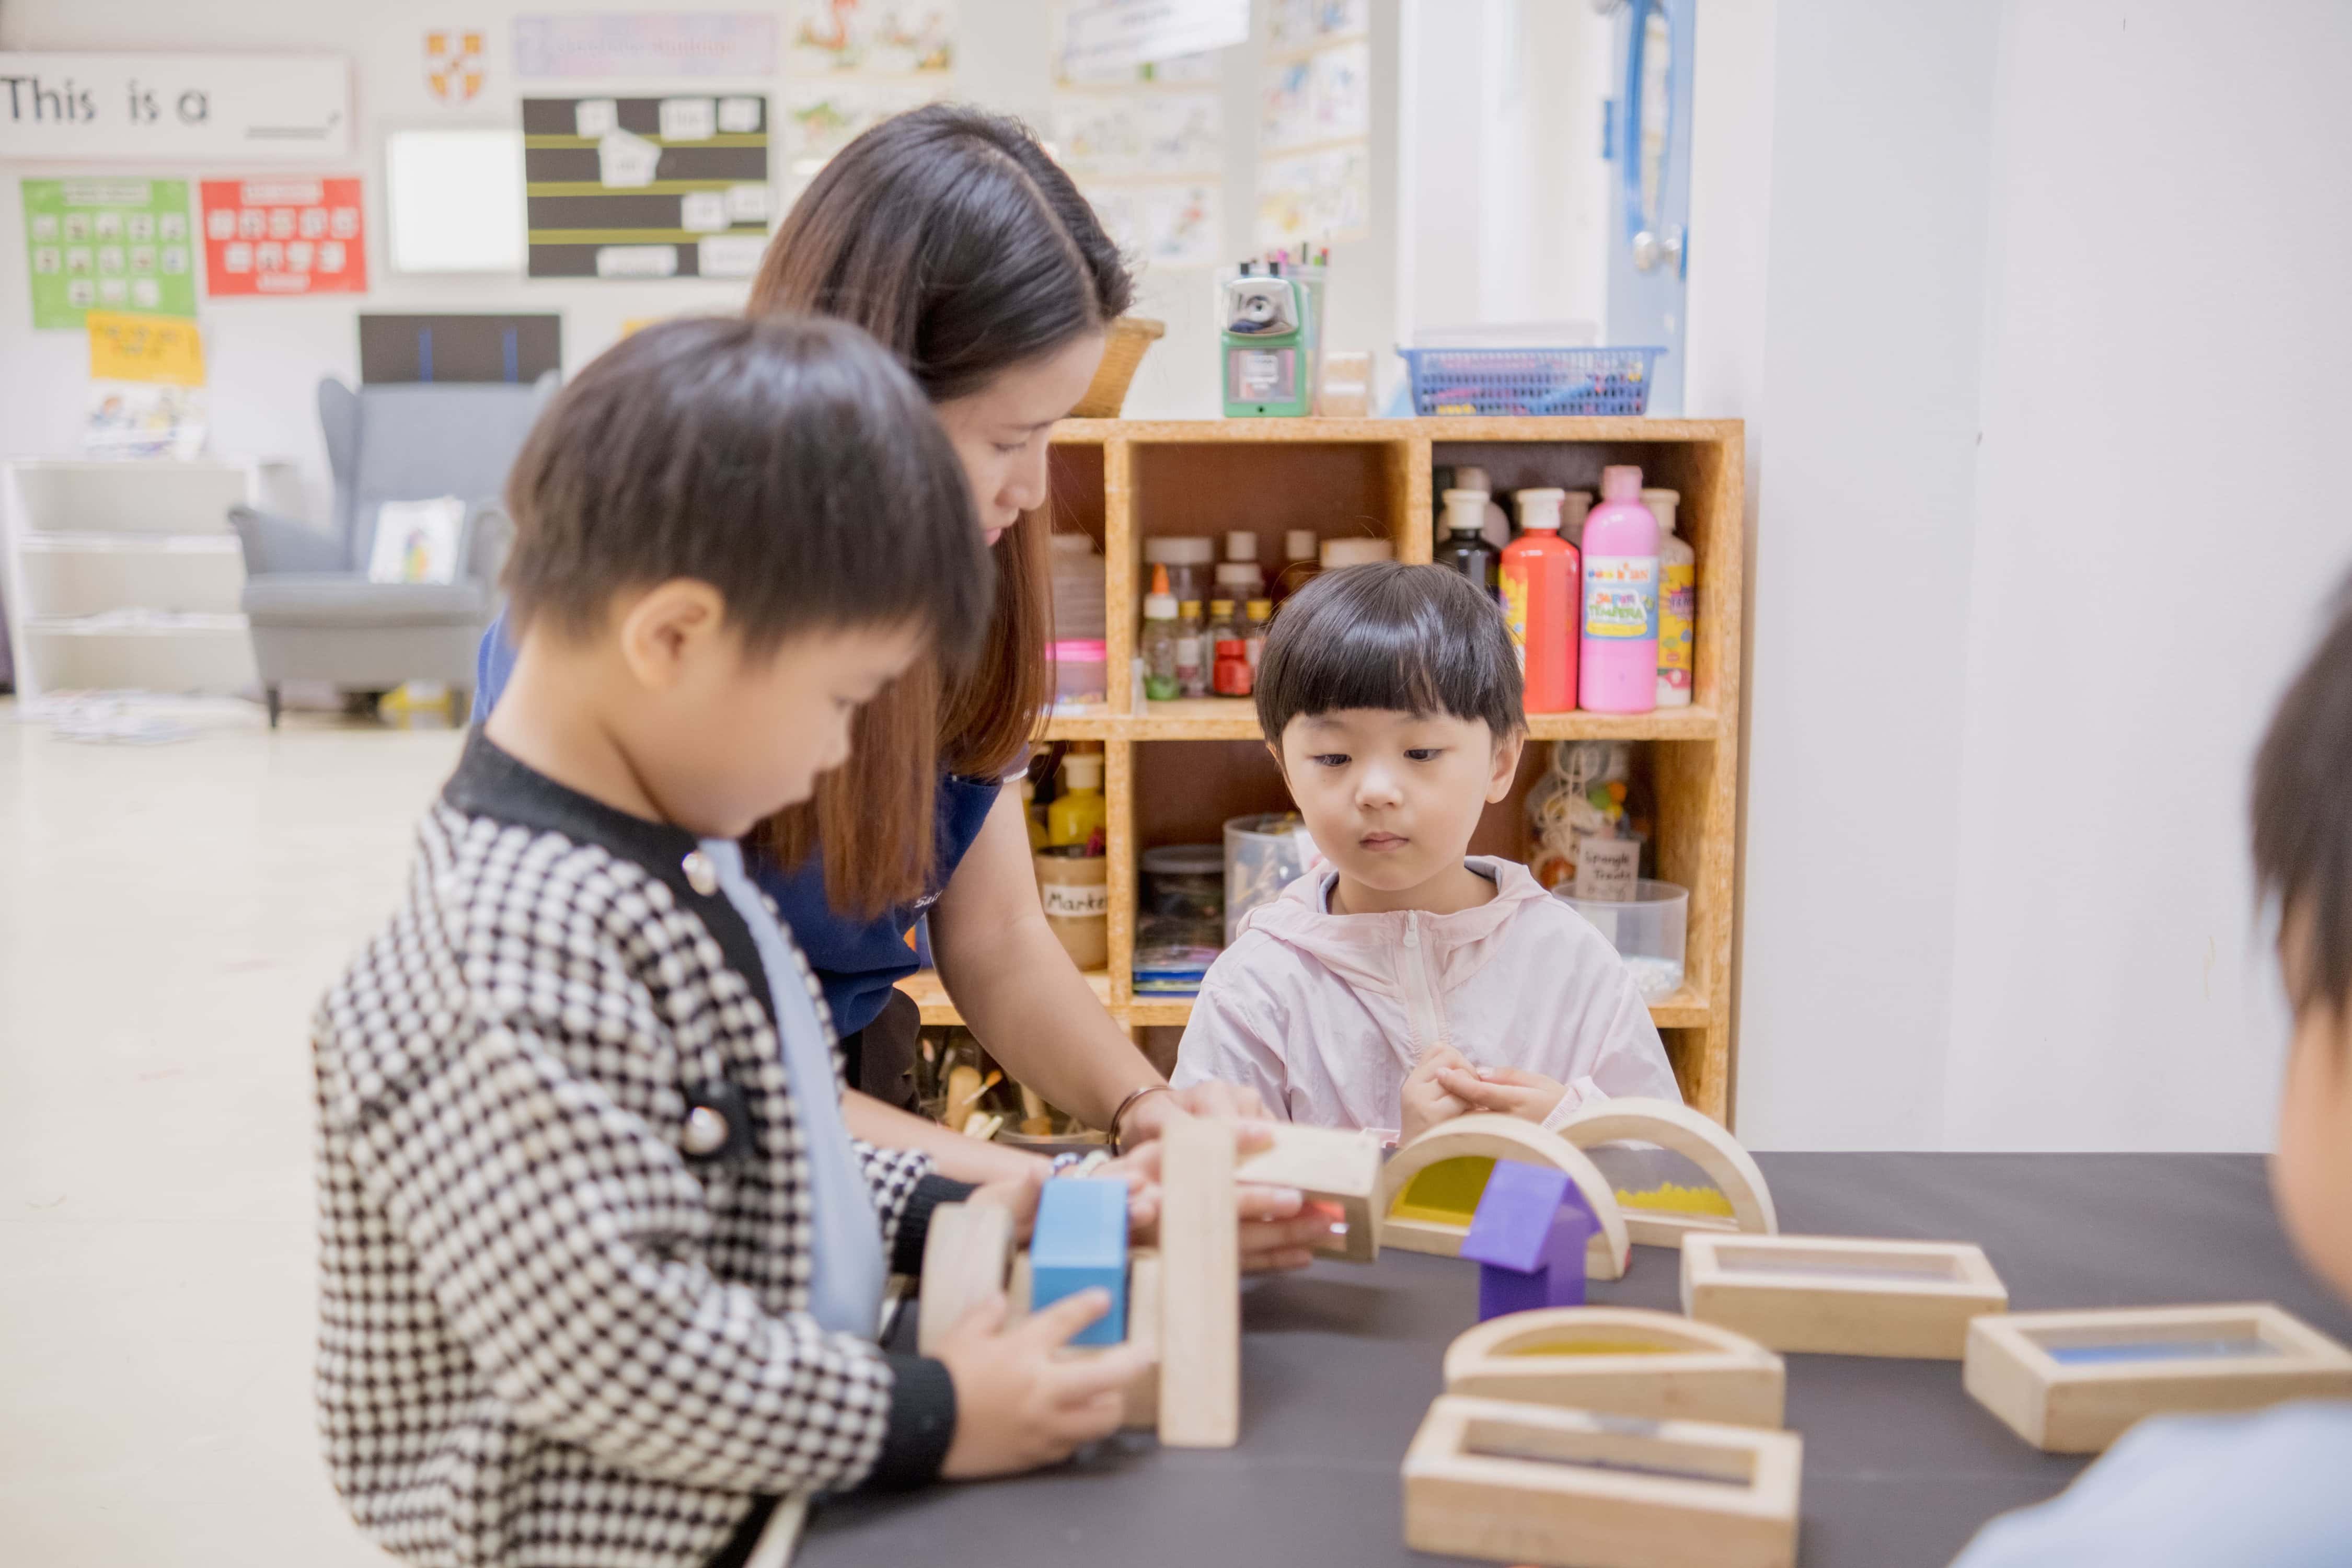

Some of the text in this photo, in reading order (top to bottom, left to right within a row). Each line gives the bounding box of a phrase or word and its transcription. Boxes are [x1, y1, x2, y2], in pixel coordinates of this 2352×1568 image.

[0, 74, 209, 123] This is a
